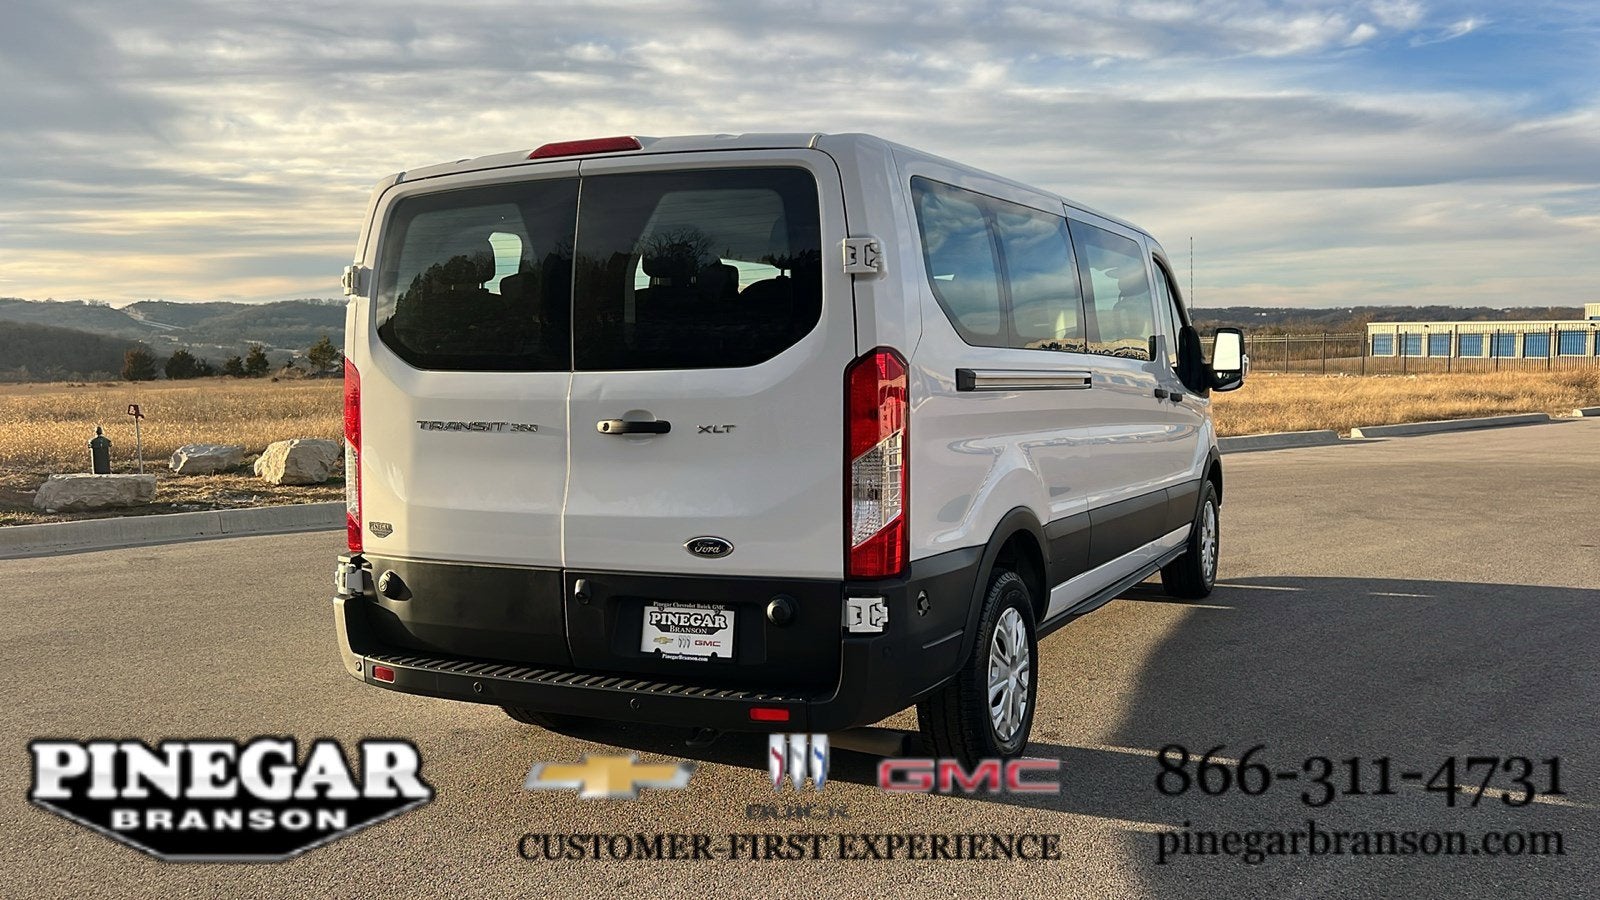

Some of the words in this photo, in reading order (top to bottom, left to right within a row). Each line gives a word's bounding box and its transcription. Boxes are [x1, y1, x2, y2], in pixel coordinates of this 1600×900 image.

[416, 420, 508, 432] TRANSIT
[697, 424, 736, 434] XLT
[694, 541, 721, 553] Ford
[650, 612, 727, 629] PINEGAR
[669, 625, 708, 634] BRANSON
